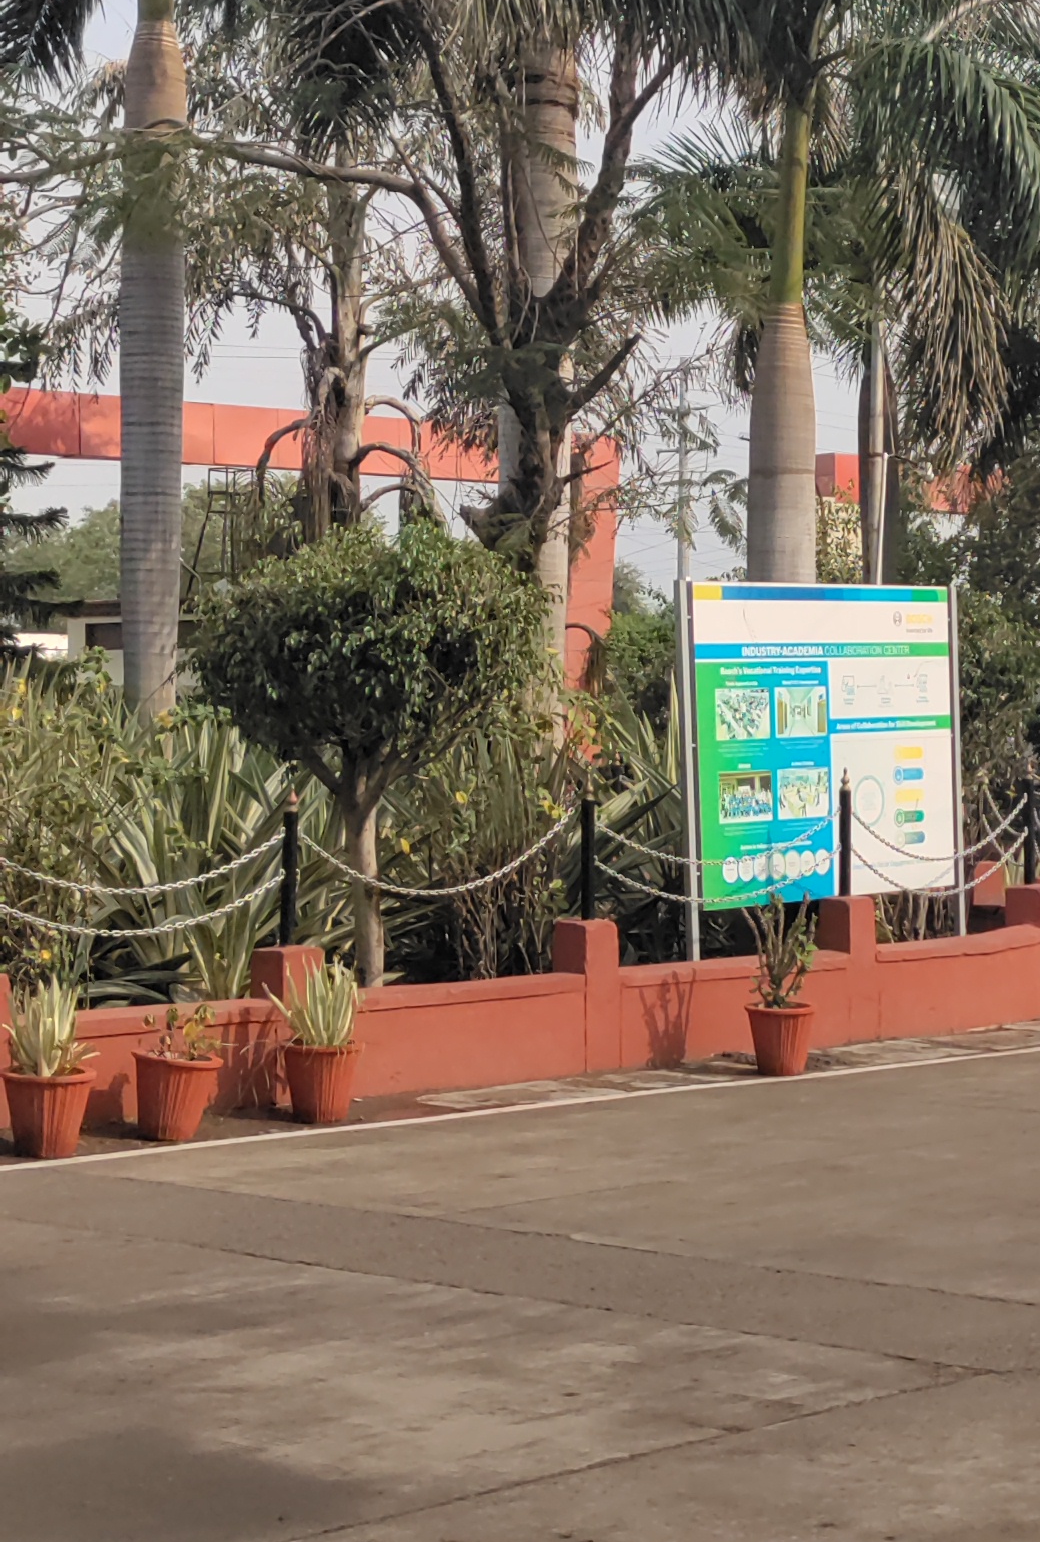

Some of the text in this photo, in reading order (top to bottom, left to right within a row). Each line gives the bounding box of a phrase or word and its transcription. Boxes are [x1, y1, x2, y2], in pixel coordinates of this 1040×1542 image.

[742, 645, 910, 656] INDUSTRY-ACADEMIA COLLABORATION CENTER
